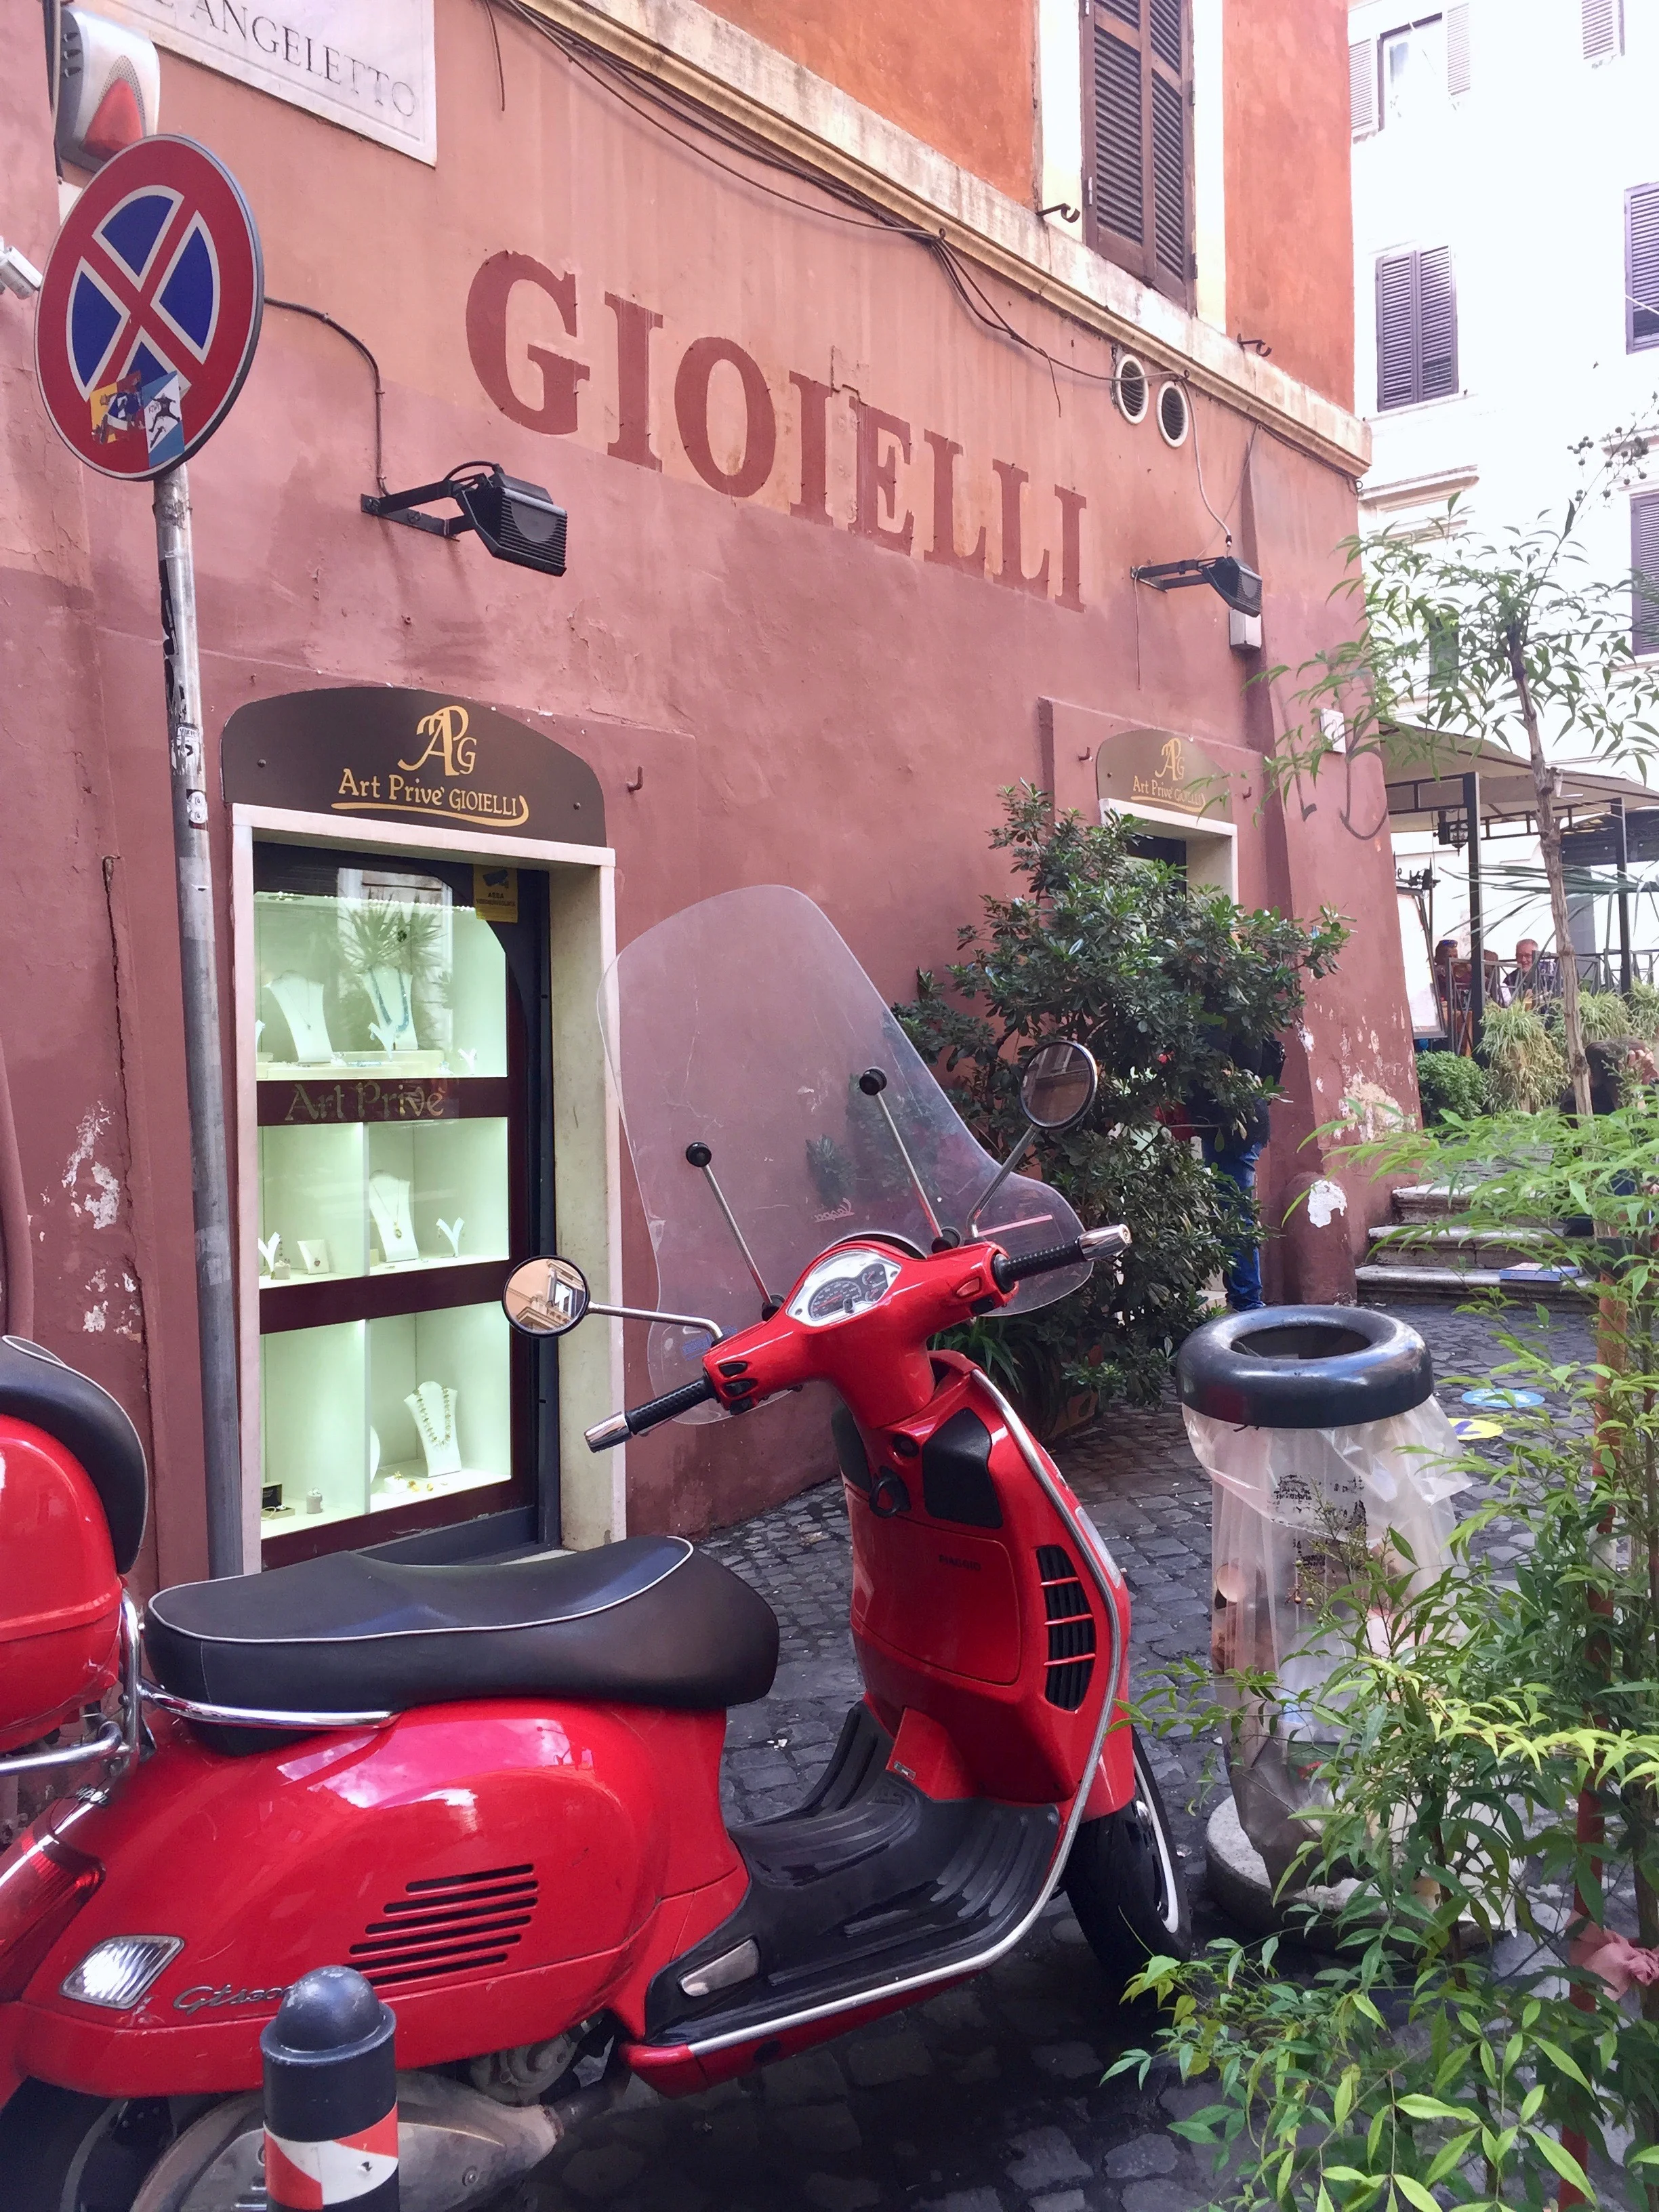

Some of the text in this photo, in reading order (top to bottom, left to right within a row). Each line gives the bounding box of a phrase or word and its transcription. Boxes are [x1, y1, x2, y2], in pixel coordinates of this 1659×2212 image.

[465, 249, 1088, 613] GIOIELLI
[338, 768, 380, 798] Art
[449, 787, 517, 817] GIOIELLI
[1132, 775, 1149, 794] Art
[285, 1084, 345, 1121] Art
